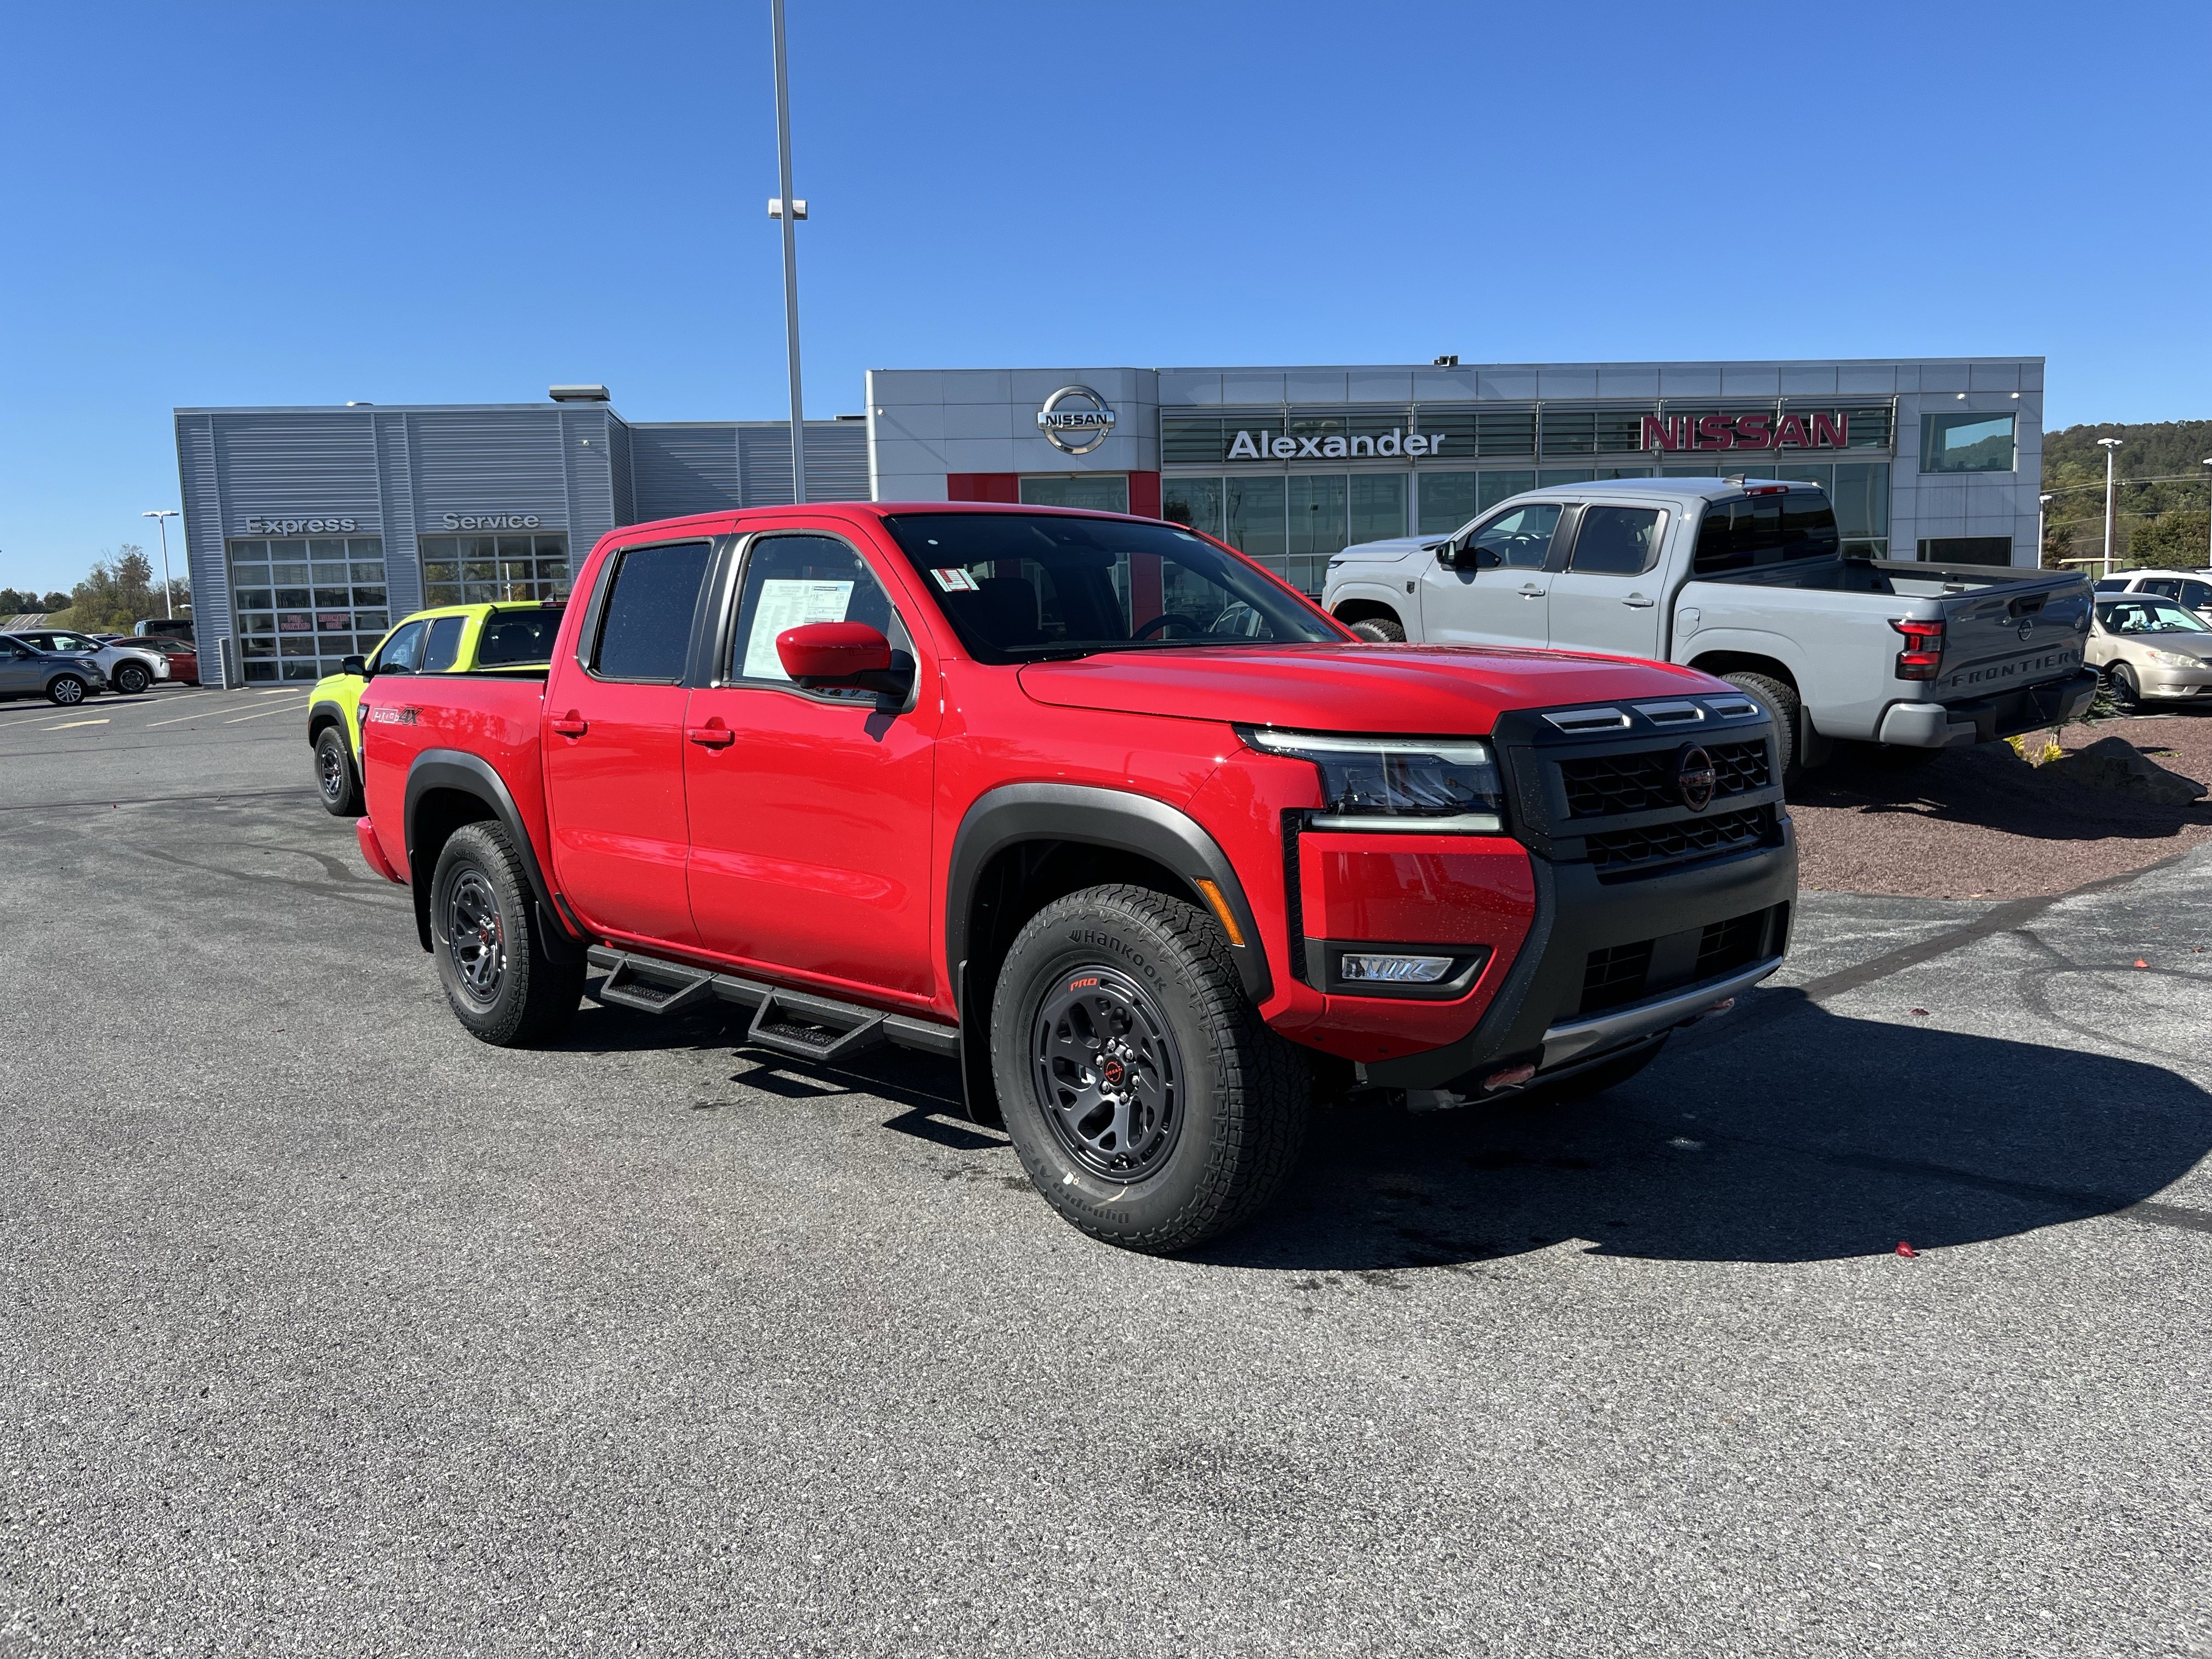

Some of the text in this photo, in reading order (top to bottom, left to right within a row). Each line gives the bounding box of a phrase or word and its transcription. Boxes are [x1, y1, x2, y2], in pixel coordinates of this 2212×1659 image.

[1046, 414, 1107, 426] NISSAN
[1641, 414, 1848, 450] NISSAN
[1228, 428, 1445, 458] Alexander
[245, 516, 357, 537] Express
[443, 513, 539, 530] Service
[281, 622, 311, 630] FORWARD
[318, 614, 349, 622] AUTOMATIC
[1951, 652, 2069, 687] FRONTIER
[1070, 978, 1098, 992] PRO
[1052, 1182, 1130, 1224] Dynapro
